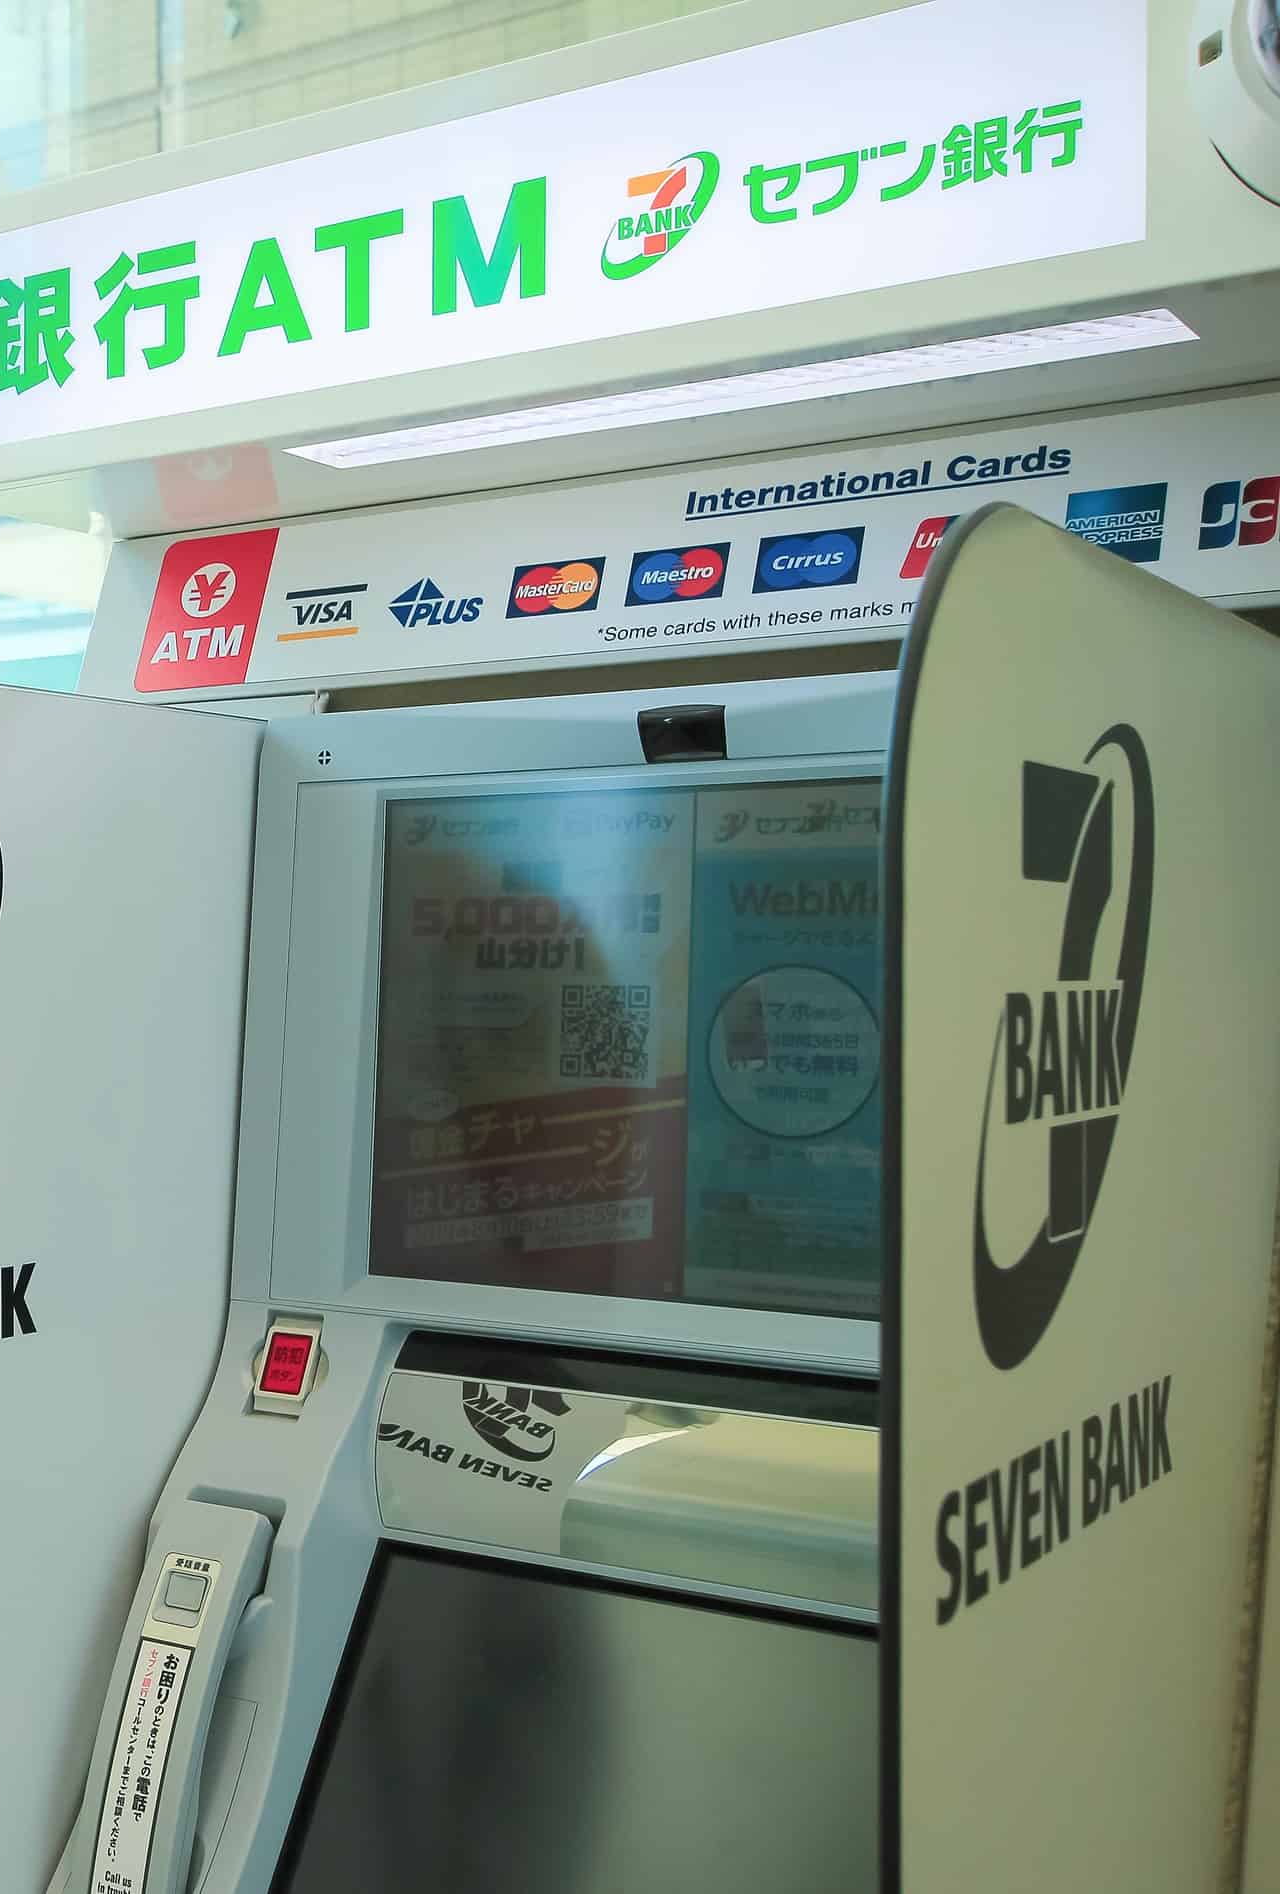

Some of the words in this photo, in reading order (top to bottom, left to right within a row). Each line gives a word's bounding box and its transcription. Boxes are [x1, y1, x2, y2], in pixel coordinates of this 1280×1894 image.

[743, 99, 1083, 224] セブン銀行
[618, 204, 693, 240] BANK
[686, 460, 931, 515] International
[947, 445, 1072, 483] Cards
[1065, 510, 1160, 531] AMERICAN
[1083, 525, 1163, 544] EXPRESS
[641, 564, 714, 585] Maestro
[772, 550, 844, 571] Cirrus
[515, 577, 597, 600] MasterCard
[291, 600, 352, 626] VISA
[408, 597, 483, 628] PLUS
[664, 618, 716, 637] cards
[722, 613, 761, 631] with
[768, 608, 822, 627] these
[830, 601, 893, 621] marks
[150, 624, 245, 664] ATM
[1005, 988, 1122, 1125] BANK
[936, 1430, 1070, 1625] SEVEN
[1082, 1375, 1172, 1529] BANK
[105, 1870, 121, 1885] Call
[122, 1877, 132, 1888] us
